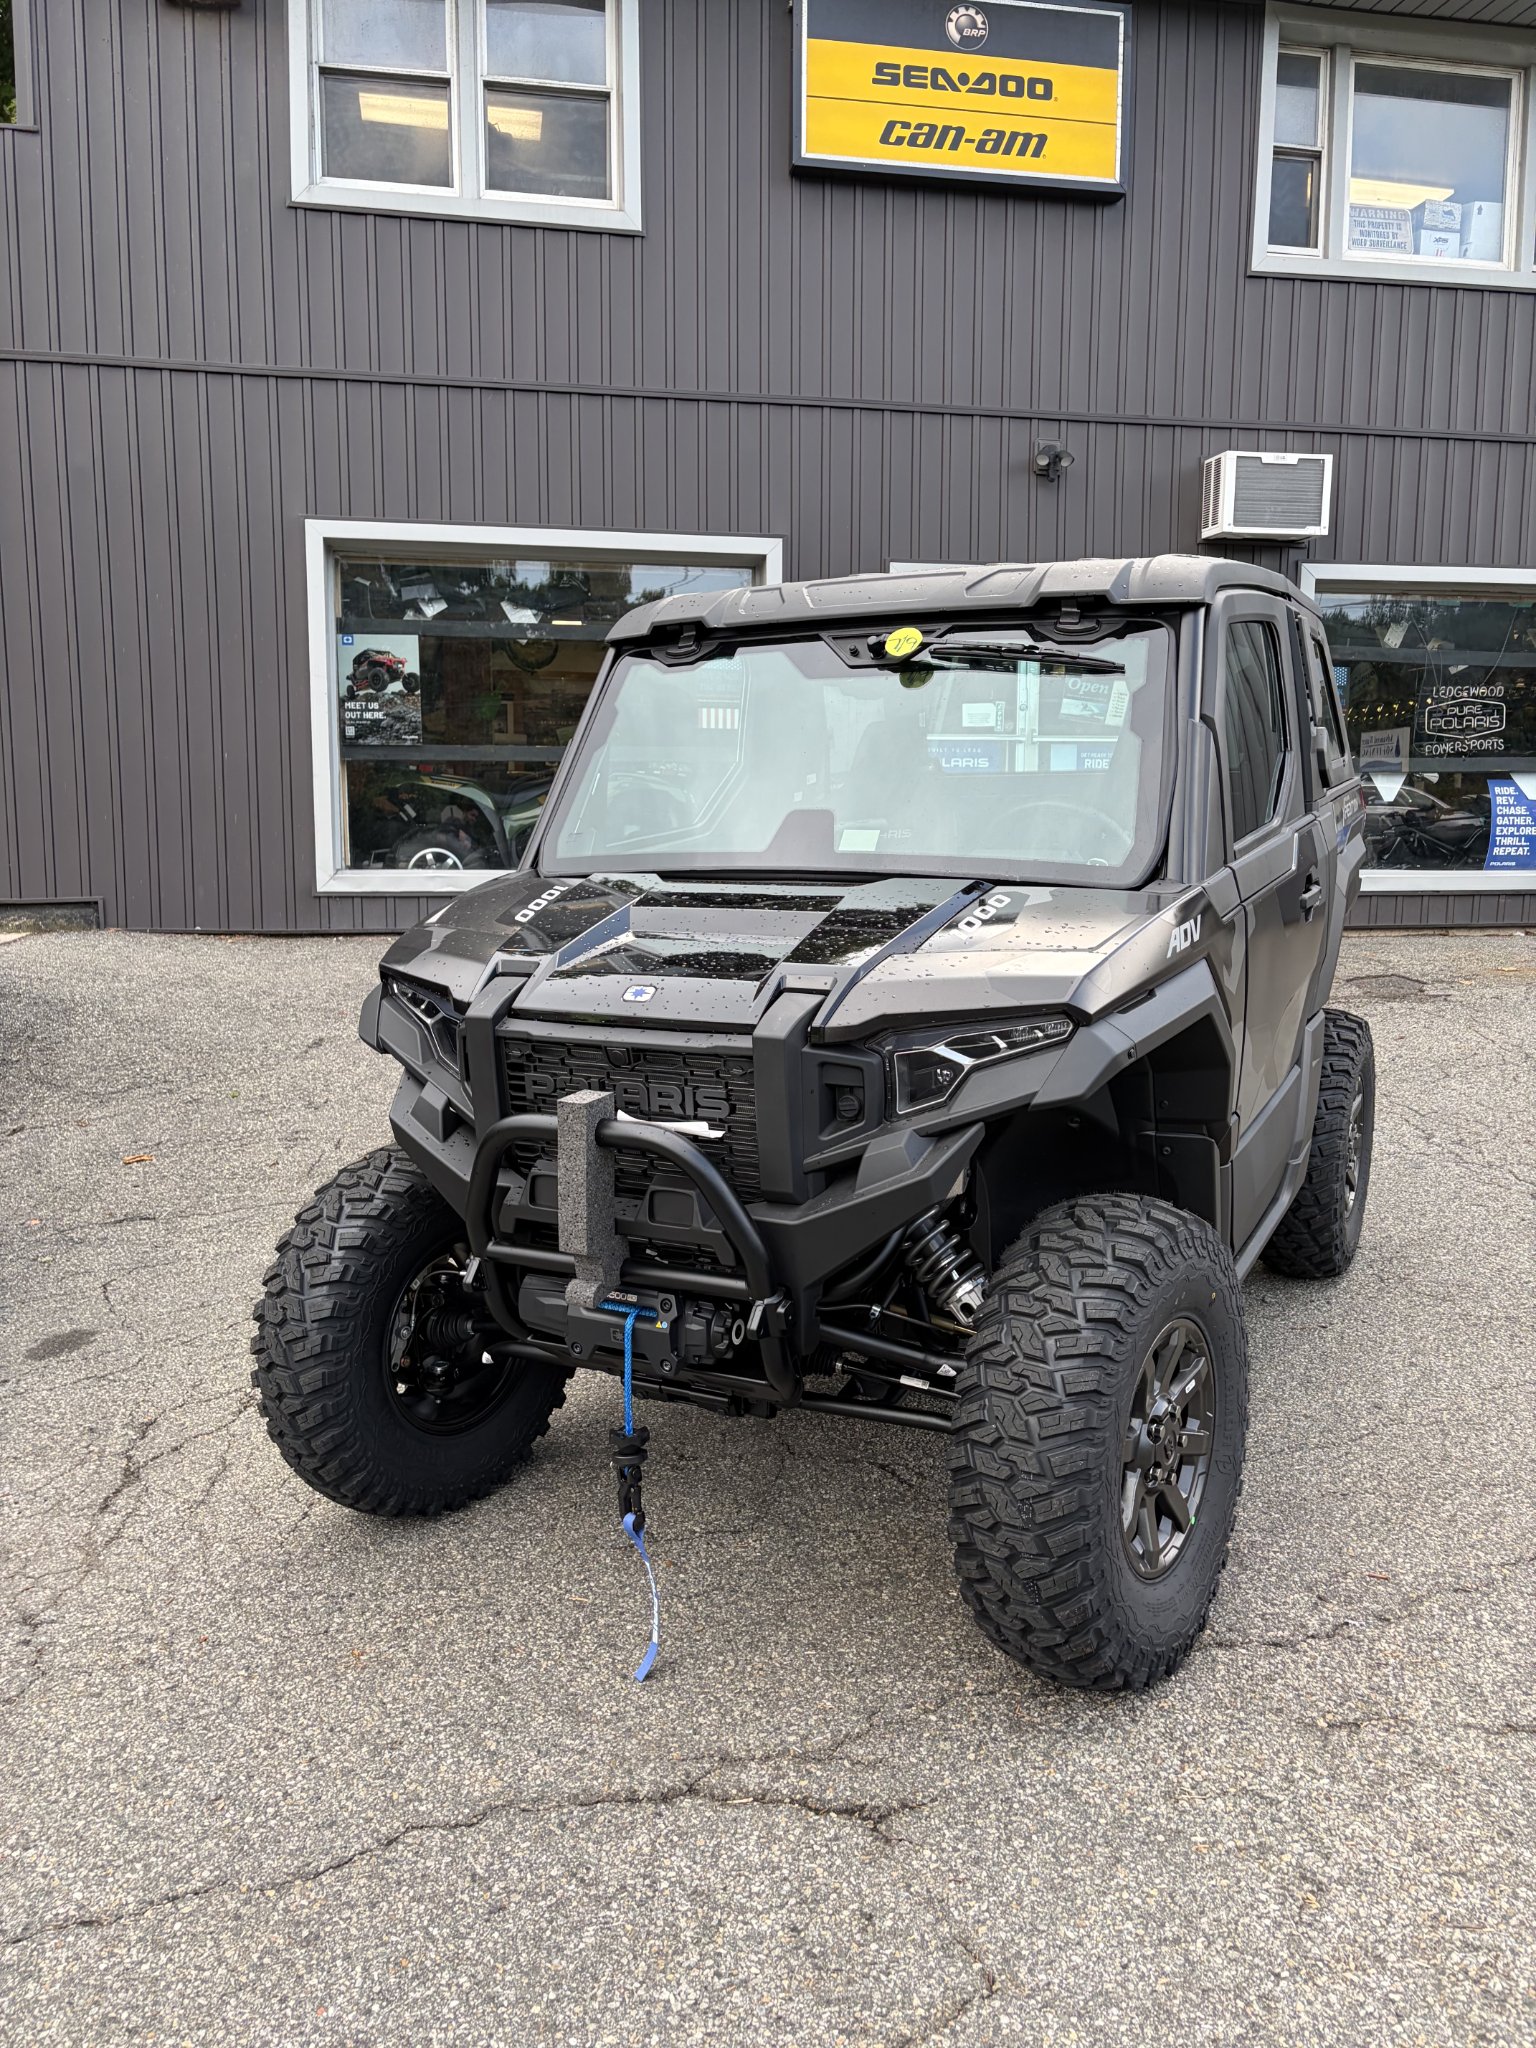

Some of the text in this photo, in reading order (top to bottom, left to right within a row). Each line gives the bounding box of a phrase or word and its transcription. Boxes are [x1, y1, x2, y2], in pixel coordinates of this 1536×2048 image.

[963, 28, 986, 38] BRP
[1350, 207, 1406, 220] WARNING
[1353, 220, 1366, 229] THIS
[1068, 677, 1110, 695] Open
[1433, 686, 1504, 698] LEDGEWOOD
[345, 711, 361, 719] OUT
[1447, 705, 1483, 716] PURE
[1430, 715, 1500, 730] POLARIS
[940, 757, 989, 768] LARIS
[1085, 758, 1110, 769] RIDE
[1494, 786, 1519, 795] RIDE.
[1496, 796, 1517, 805] REV.
[1496, 806, 1530, 815] CHASE.
[1496, 816, 1535, 825] GATHER.
[1495, 836, 1530, 846] THRILL.
[1492, 846, 1531, 856] REPEAT.
[514, 885, 569, 923] 1000
[948, 894, 1012, 941] 1000
[1166, 914, 1201, 959] ADV
